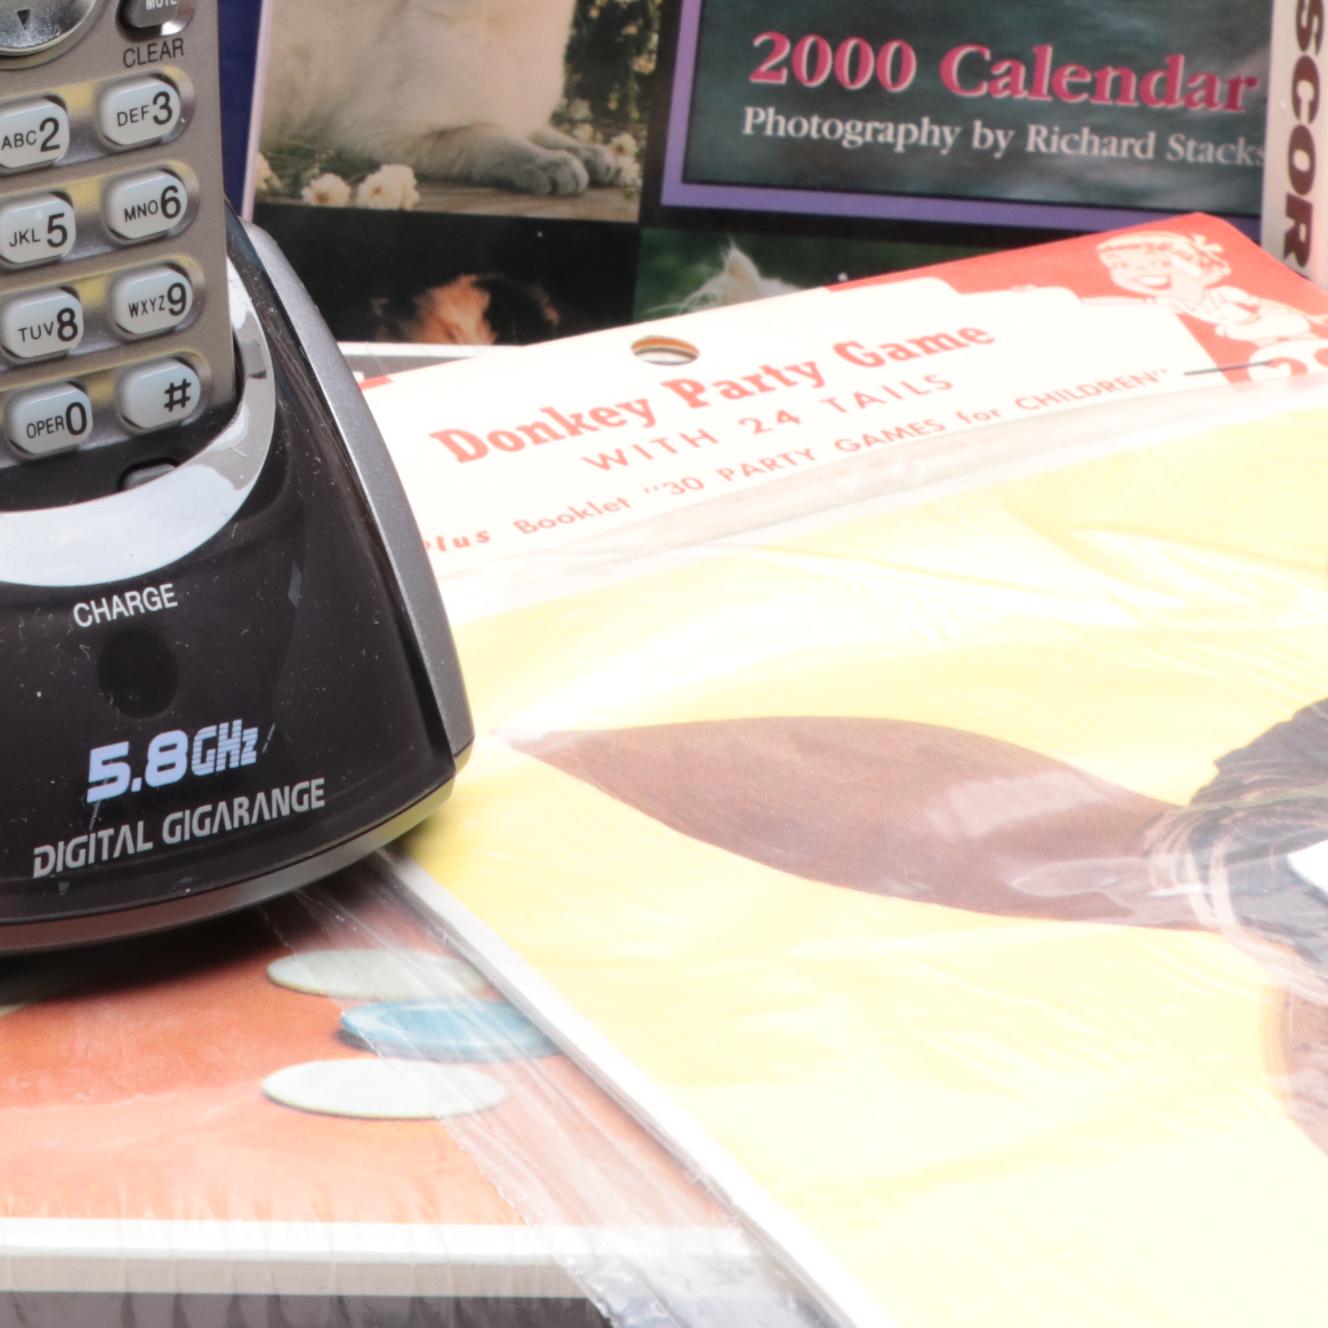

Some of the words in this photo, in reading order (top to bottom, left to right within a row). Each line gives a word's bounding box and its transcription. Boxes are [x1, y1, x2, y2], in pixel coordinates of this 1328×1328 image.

[123, 39, 185, 69] CLEAR
[749, 31, 918, 93] 2000
[939, 44, 1259, 113] Calendar
[742, 106, 961, 154] Photography
[973, 124, 1015, 158] by
[1026, 124, 1157, 162] Richard
[429, 398, 657, 464] Donkey
[660, 360, 827, 409] Party
[832, 325, 997, 369] Game
[581, 428, 719, 471] WITH
[737, 409, 802, 436] 24
[819, 373, 954, 415] TAILS
[423, 530, 491, 552] lus
[513, 497, 631, 534] Booklet
[715, 447, 818, 482] PARTY
[834, 418, 946, 453] GAMES
[956, 407, 1002, 425] for
[73, 583, 178, 629] CHARGE
[33, 823, 154, 880] DIGITAL
[162, 777, 327, 845] GIGARANGE
